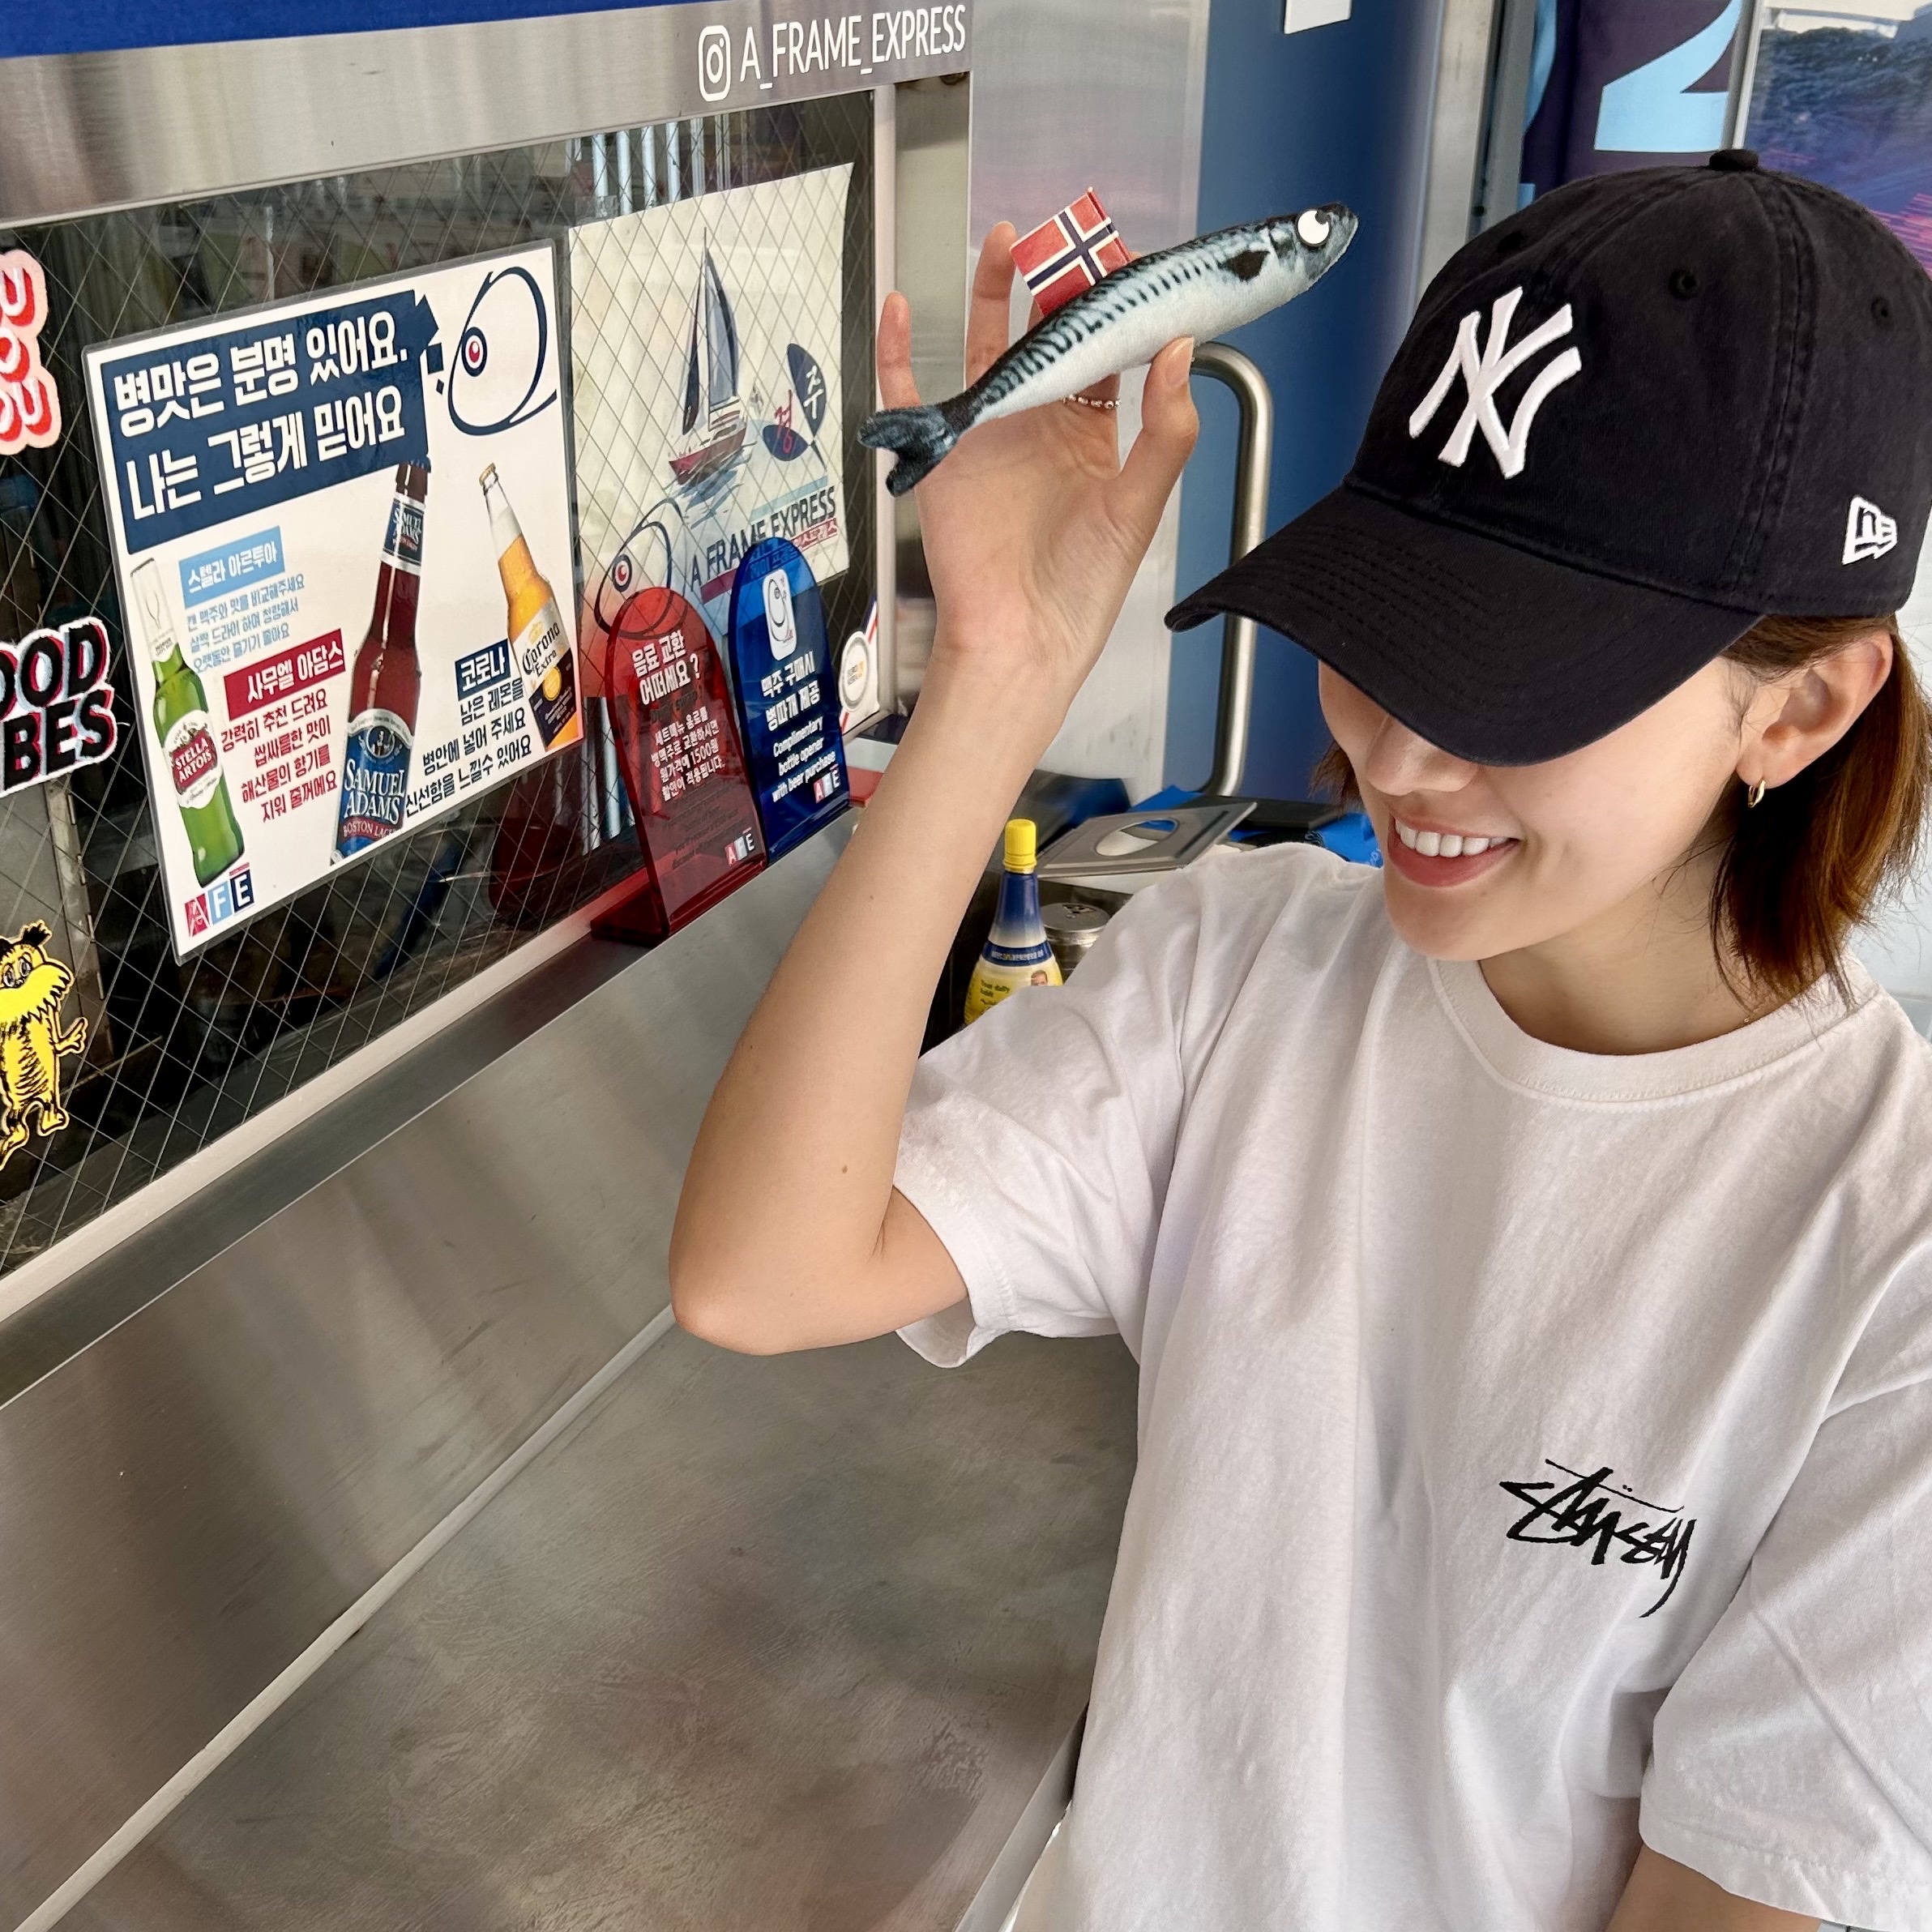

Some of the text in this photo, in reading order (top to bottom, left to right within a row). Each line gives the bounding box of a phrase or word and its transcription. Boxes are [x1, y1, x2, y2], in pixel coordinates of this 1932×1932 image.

[113, 310, 408, 438] 병맛은 분명 있어요.
[1408, 285, 1582, 480] NY
[126, 385, 405, 520] 나는 그렇게 믿어요
[690, 555, 703, 589] A
[770, 485, 836, 539] EXPRESS
[188, 541, 277, 593] 스텔라 아르투아
[199, 602, 228, 625] 맥주와
[230, 594, 250, 615] 맛을
[250, 574, 305, 607] 비교해주세요
[212, 621, 240, 644] 드라이
[263, 596, 299, 624] 청량해서
[194, 646, 231, 673] 오랫동안
[233, 634, 261, 659] 즐기기
[263, 622, 290, 646] 좋아요
[460, 646, 506, 692] 코로나
[523, 622, 560, 675] Corona
[535, 649, 558, 677] Extra
[632, 630, 686, 678] 음료 교환
[247, 645, 344, 703] 사무엘 아담스
[761, 670, 784, 698] 맥주
[784, 650, 815, 686] 구매시
[220, 717, 260, 753] 강력히
[263, 703, 289, 732] 추천
[291, 688, 328, 721] 드려요
[460, 695, 485, 727] 남은
[488, 677, 524, 713] 레몬을
[766, 680, 820, 732] 병따개 제공
[175, 737, 208, 770] STELLA
[254, 728, 304, 768] 쌉싸름한
[306, 715, 331, 744] 맛이
[422, 737, 461, 776] 병안에
[463, 724, 487, 756] 넣어
[490, 707, 526, 741] 주세요
[651, 720, 720, 768] 병맥주로 교환하시면
[655, 721, 685, 746] 세트메뉴
[690, 738, 719, 765] 1500원
[773, 716, 823, 758] Complimentary
[778, 737, 824, 776] bottle opener
[178, 748, 212, 783] ARTOIS
[241, 762, 291, 804] 해산물의
[294, 744, 331, 778] 향기를
[344, 759, 405, 798] SAMUEL
[405, 734, 532, 819] 신선함을 느낄수 있어요
[661, 776, 686, 801] 할인이
[772, 750, 836, 803] with beer purchase
[261, 794, 287, 823] 지워
[343, 821, 374, 837] BOSTON
[344, 790, 400, 825] ADAMS
[183, 870, 254, 938] AFE
